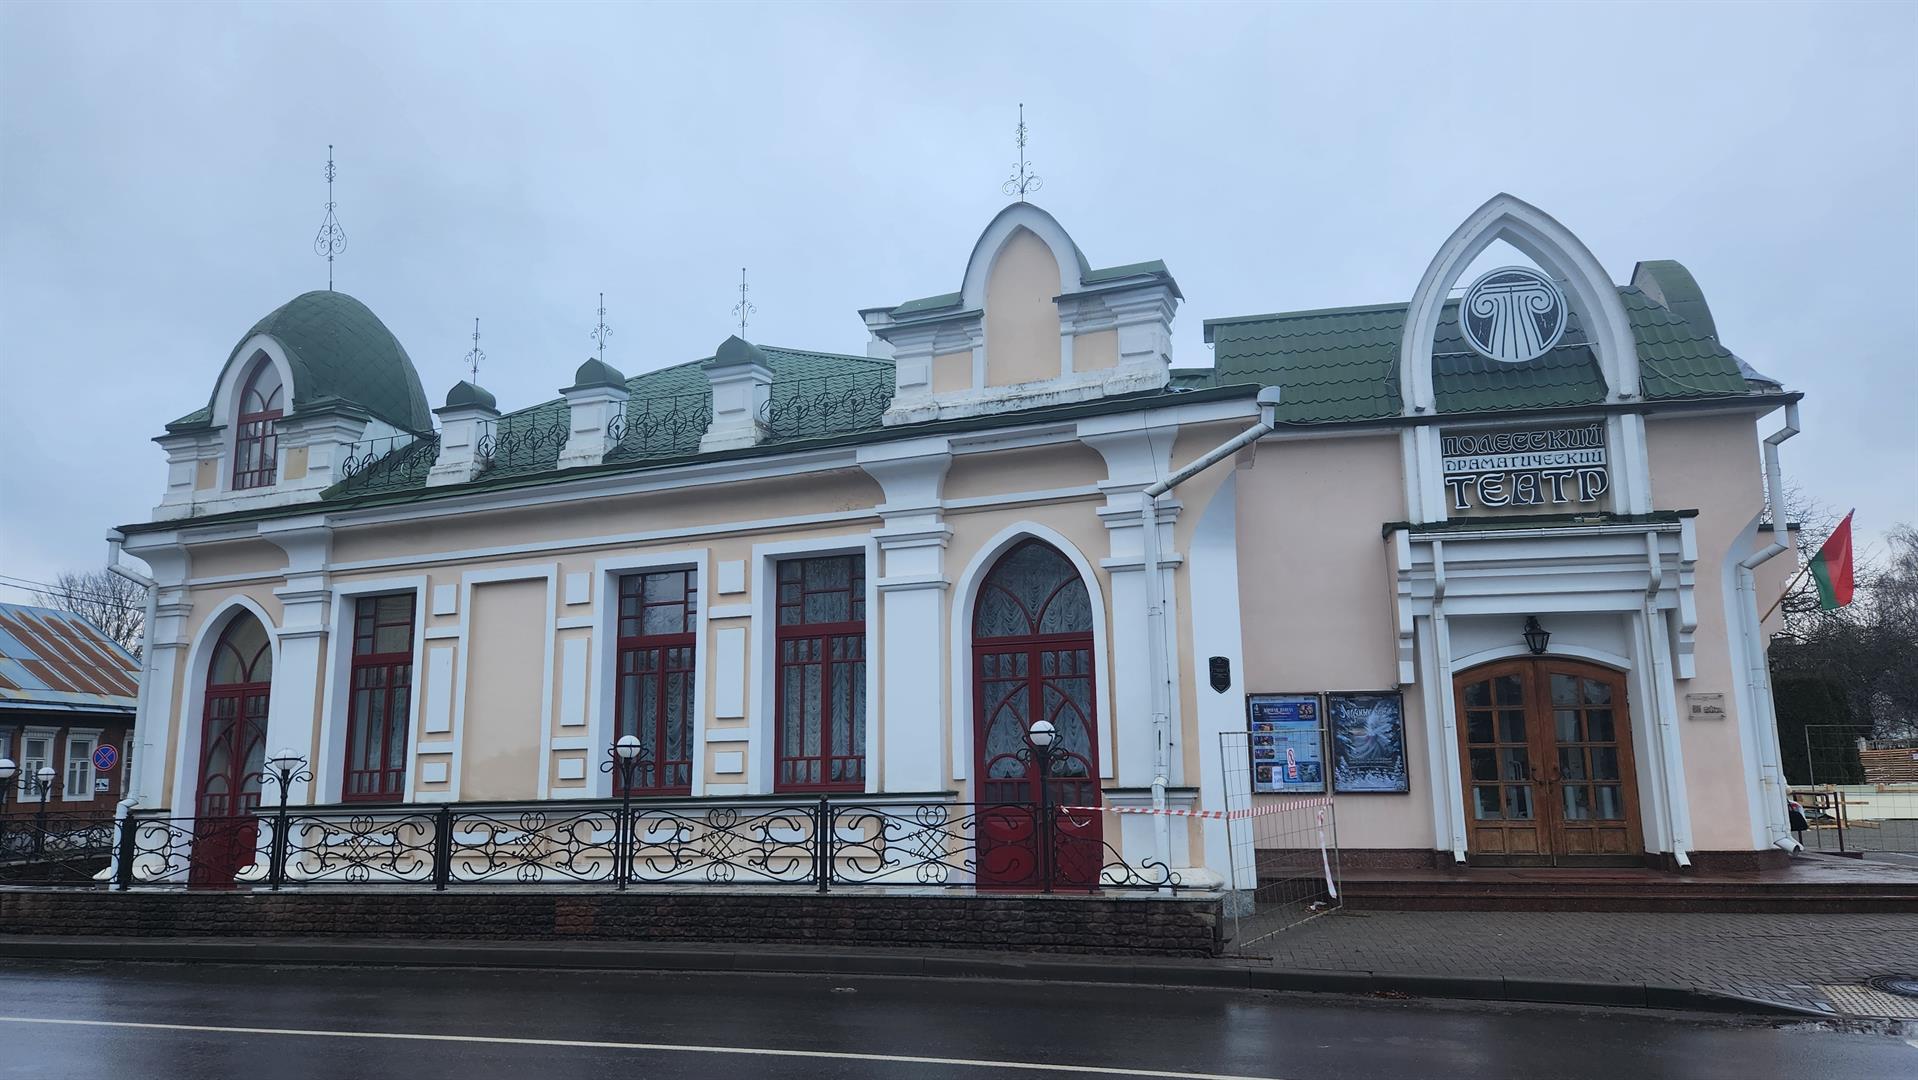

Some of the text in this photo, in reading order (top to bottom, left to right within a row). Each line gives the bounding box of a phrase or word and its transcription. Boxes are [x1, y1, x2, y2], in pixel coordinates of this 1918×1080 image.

[1443, 424, 1604, 455] ПОЛЕССКИЙ
[1446, 450, 1602, 471] ДРАМАТИЧЕСКИЙ
[1445, 469, 1608, 509] ТЕАТР
